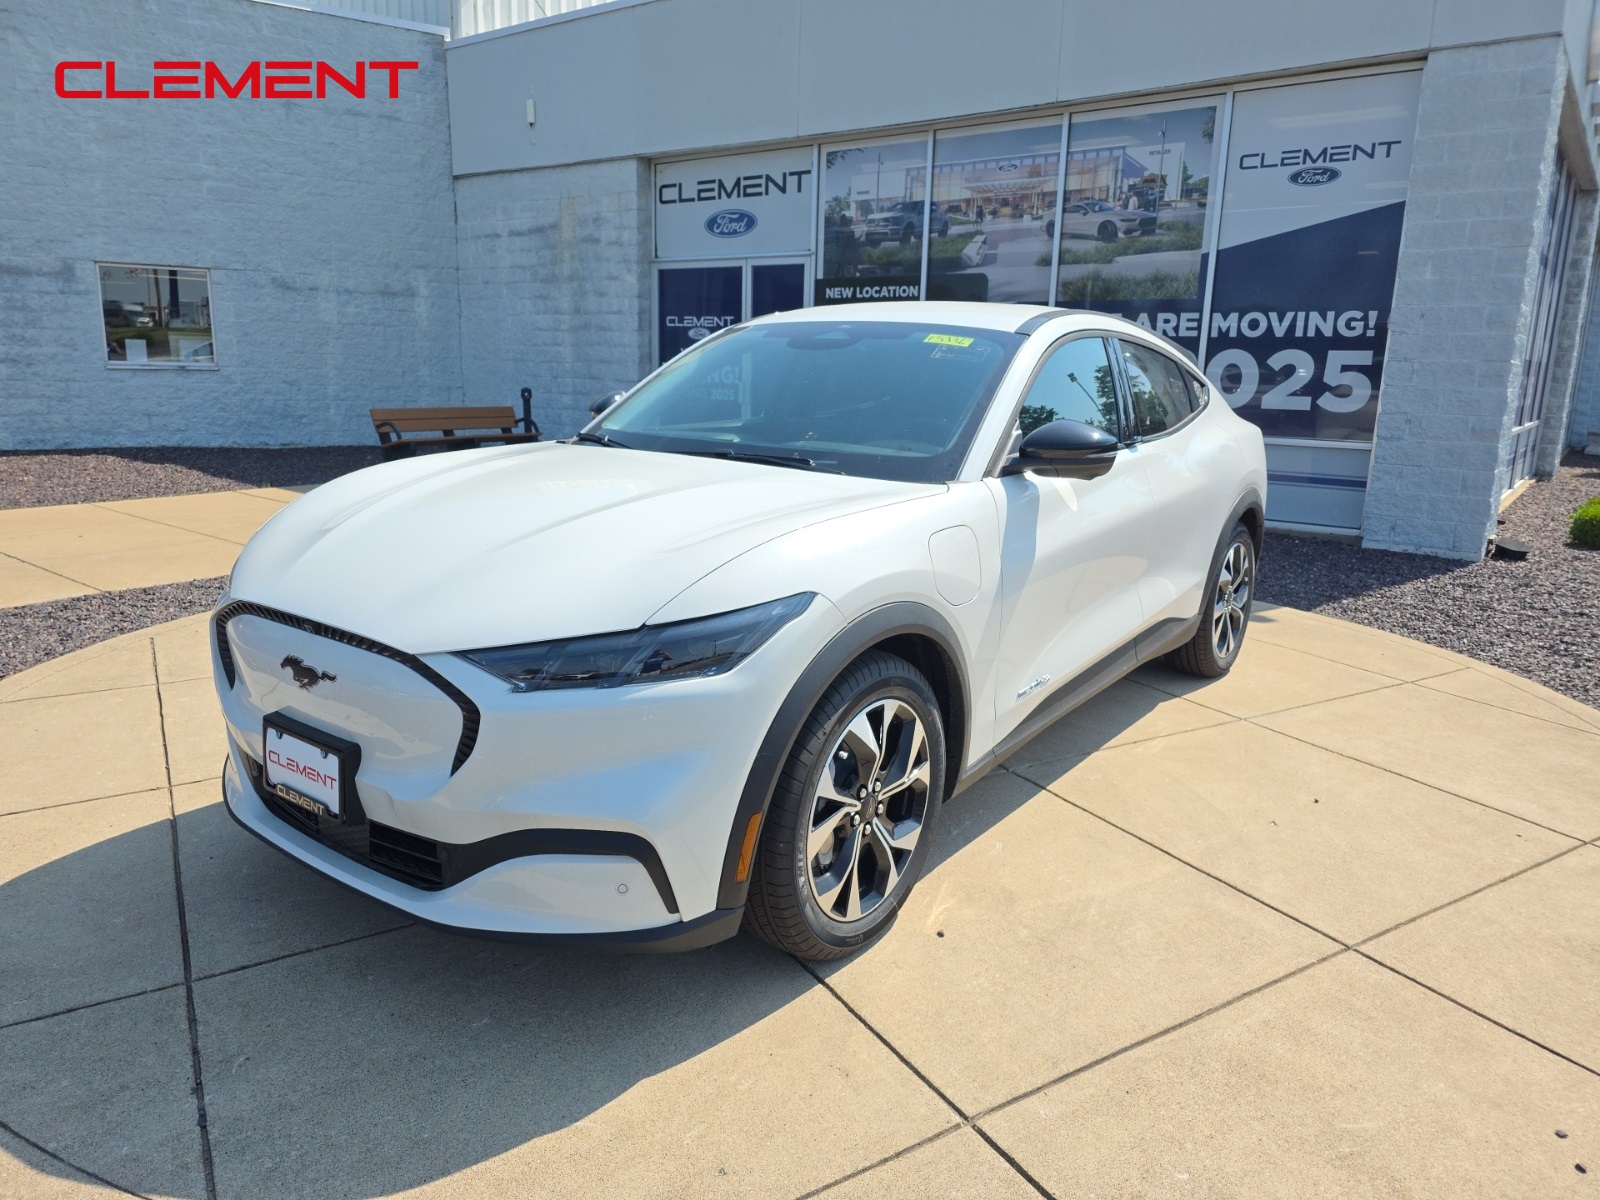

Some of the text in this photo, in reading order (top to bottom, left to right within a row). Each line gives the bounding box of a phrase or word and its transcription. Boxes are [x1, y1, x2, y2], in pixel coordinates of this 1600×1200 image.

[1239, 140, 1402, 170] CLEMENT
[659, 170, 811, 205] CLEMENT
[825, 285, 919, 299] NEW LOCATION
[666, 316, 735, 327] CLEMENT
[1136, 310, 1378, 338] ARE MOVING!
[1202, 349, 1375, 413] 025
[268, 750, 337, 789] CLEMENT
[276, 784, 325, 815] CLEMENT
